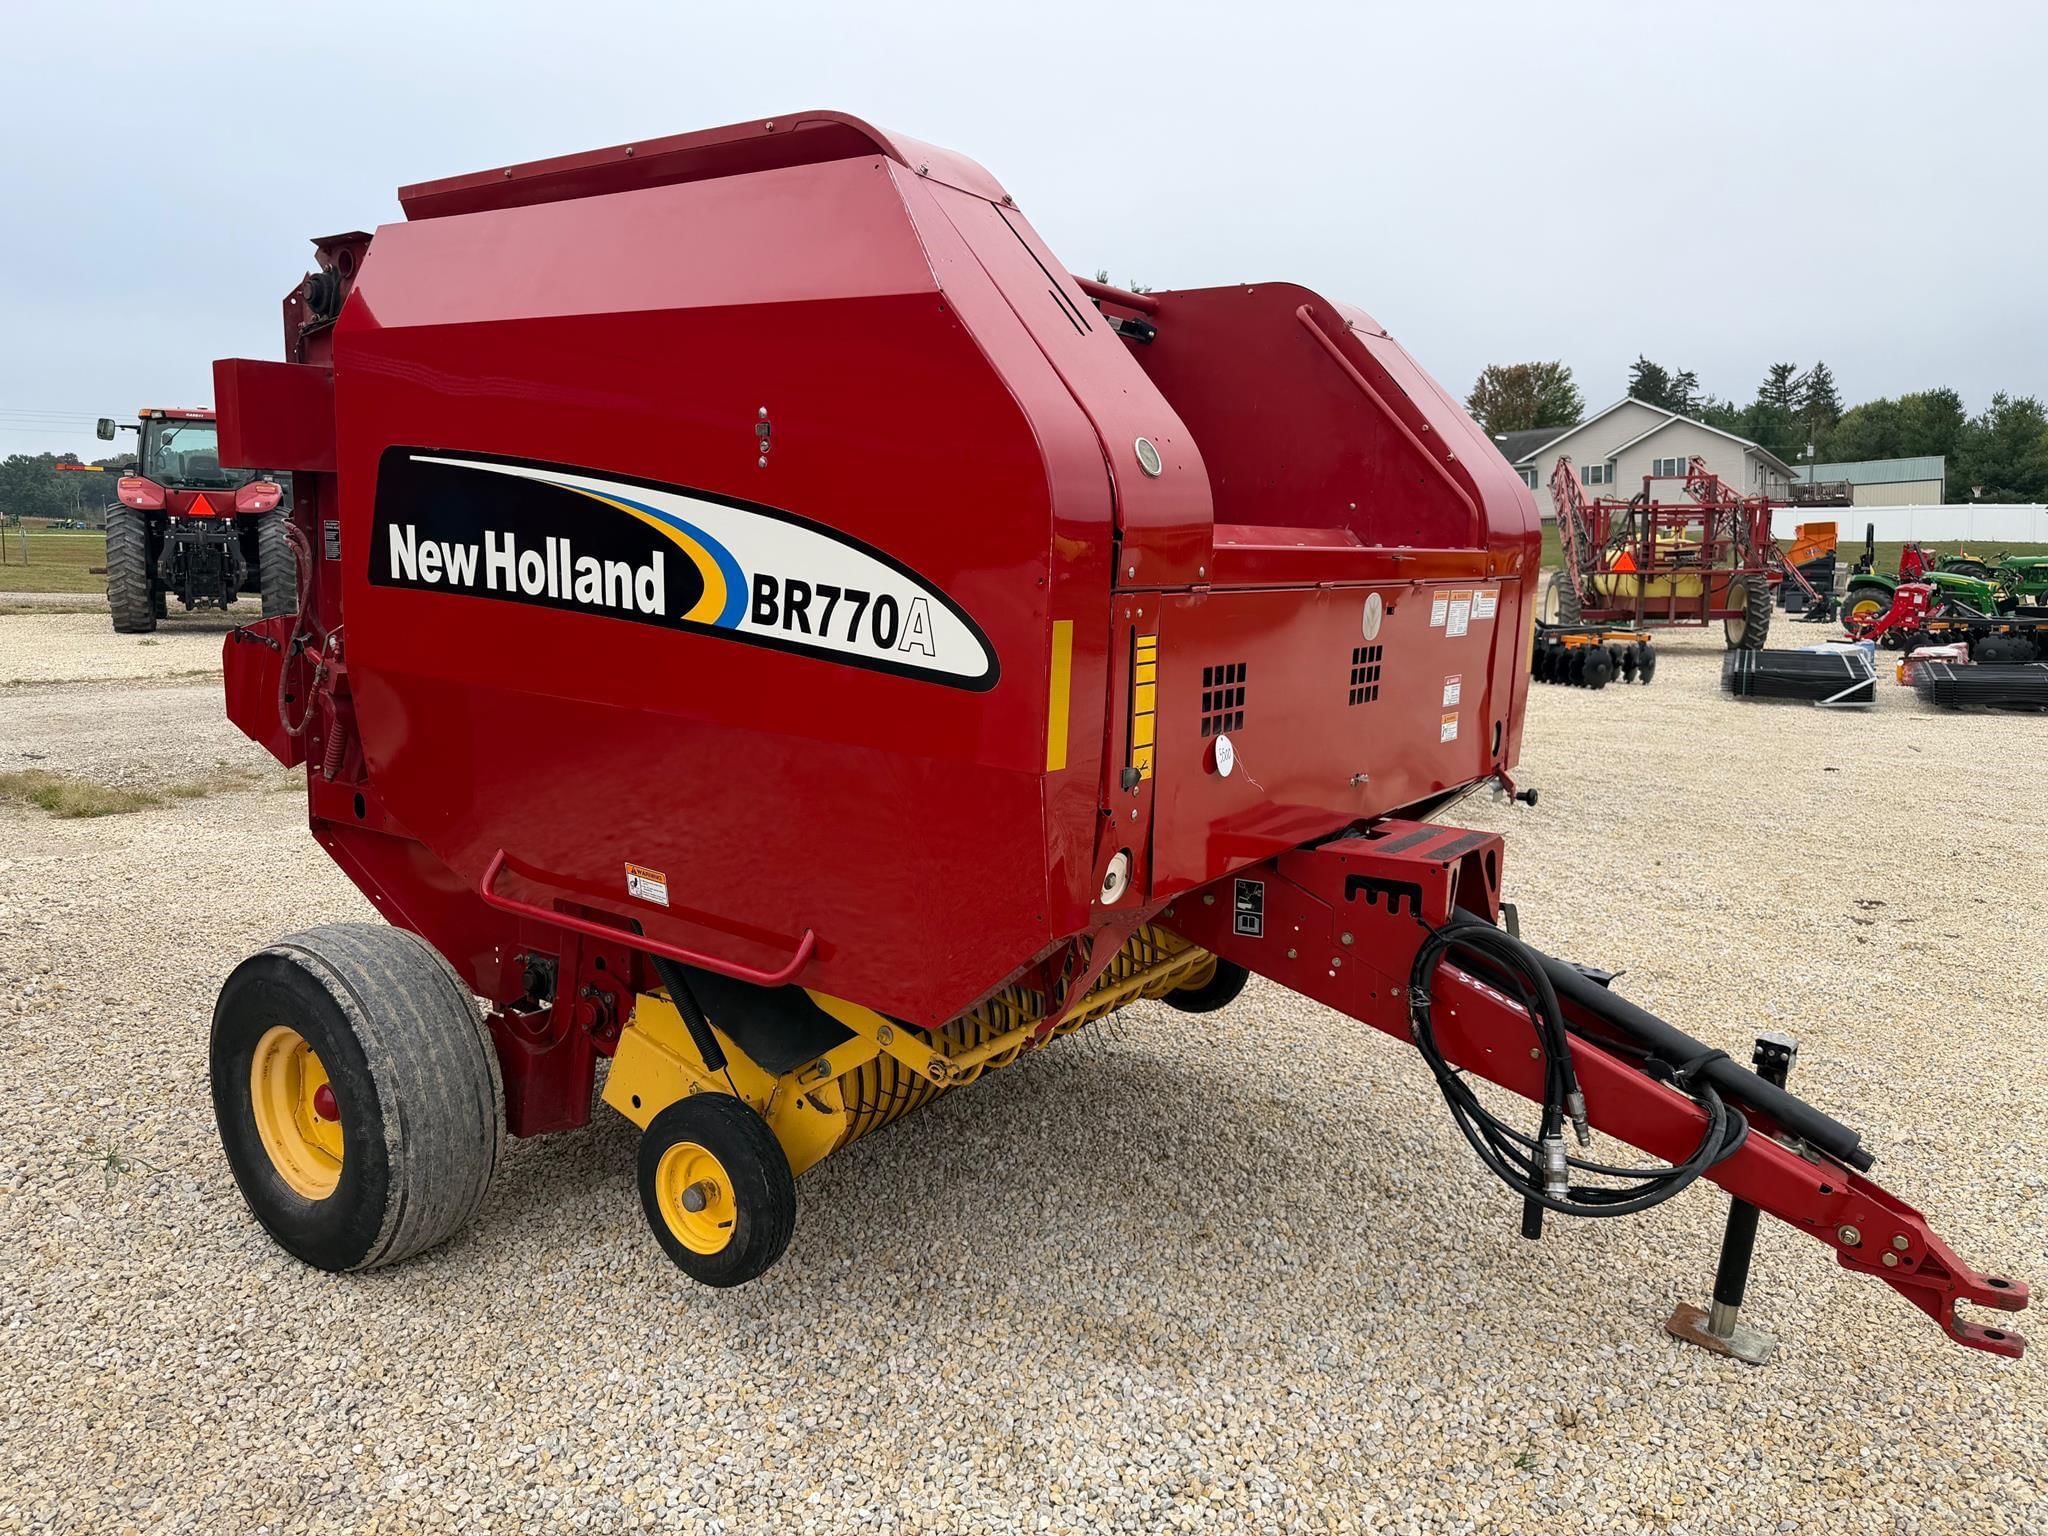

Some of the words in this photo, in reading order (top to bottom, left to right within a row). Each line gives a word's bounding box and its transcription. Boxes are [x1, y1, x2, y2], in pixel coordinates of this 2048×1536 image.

[389, 523, 478, 586] New
[485, 531, 666, 615] Holland
[751, 573, 936, 657] BR770A
[1458, 971, 1524, 1011] 5500
